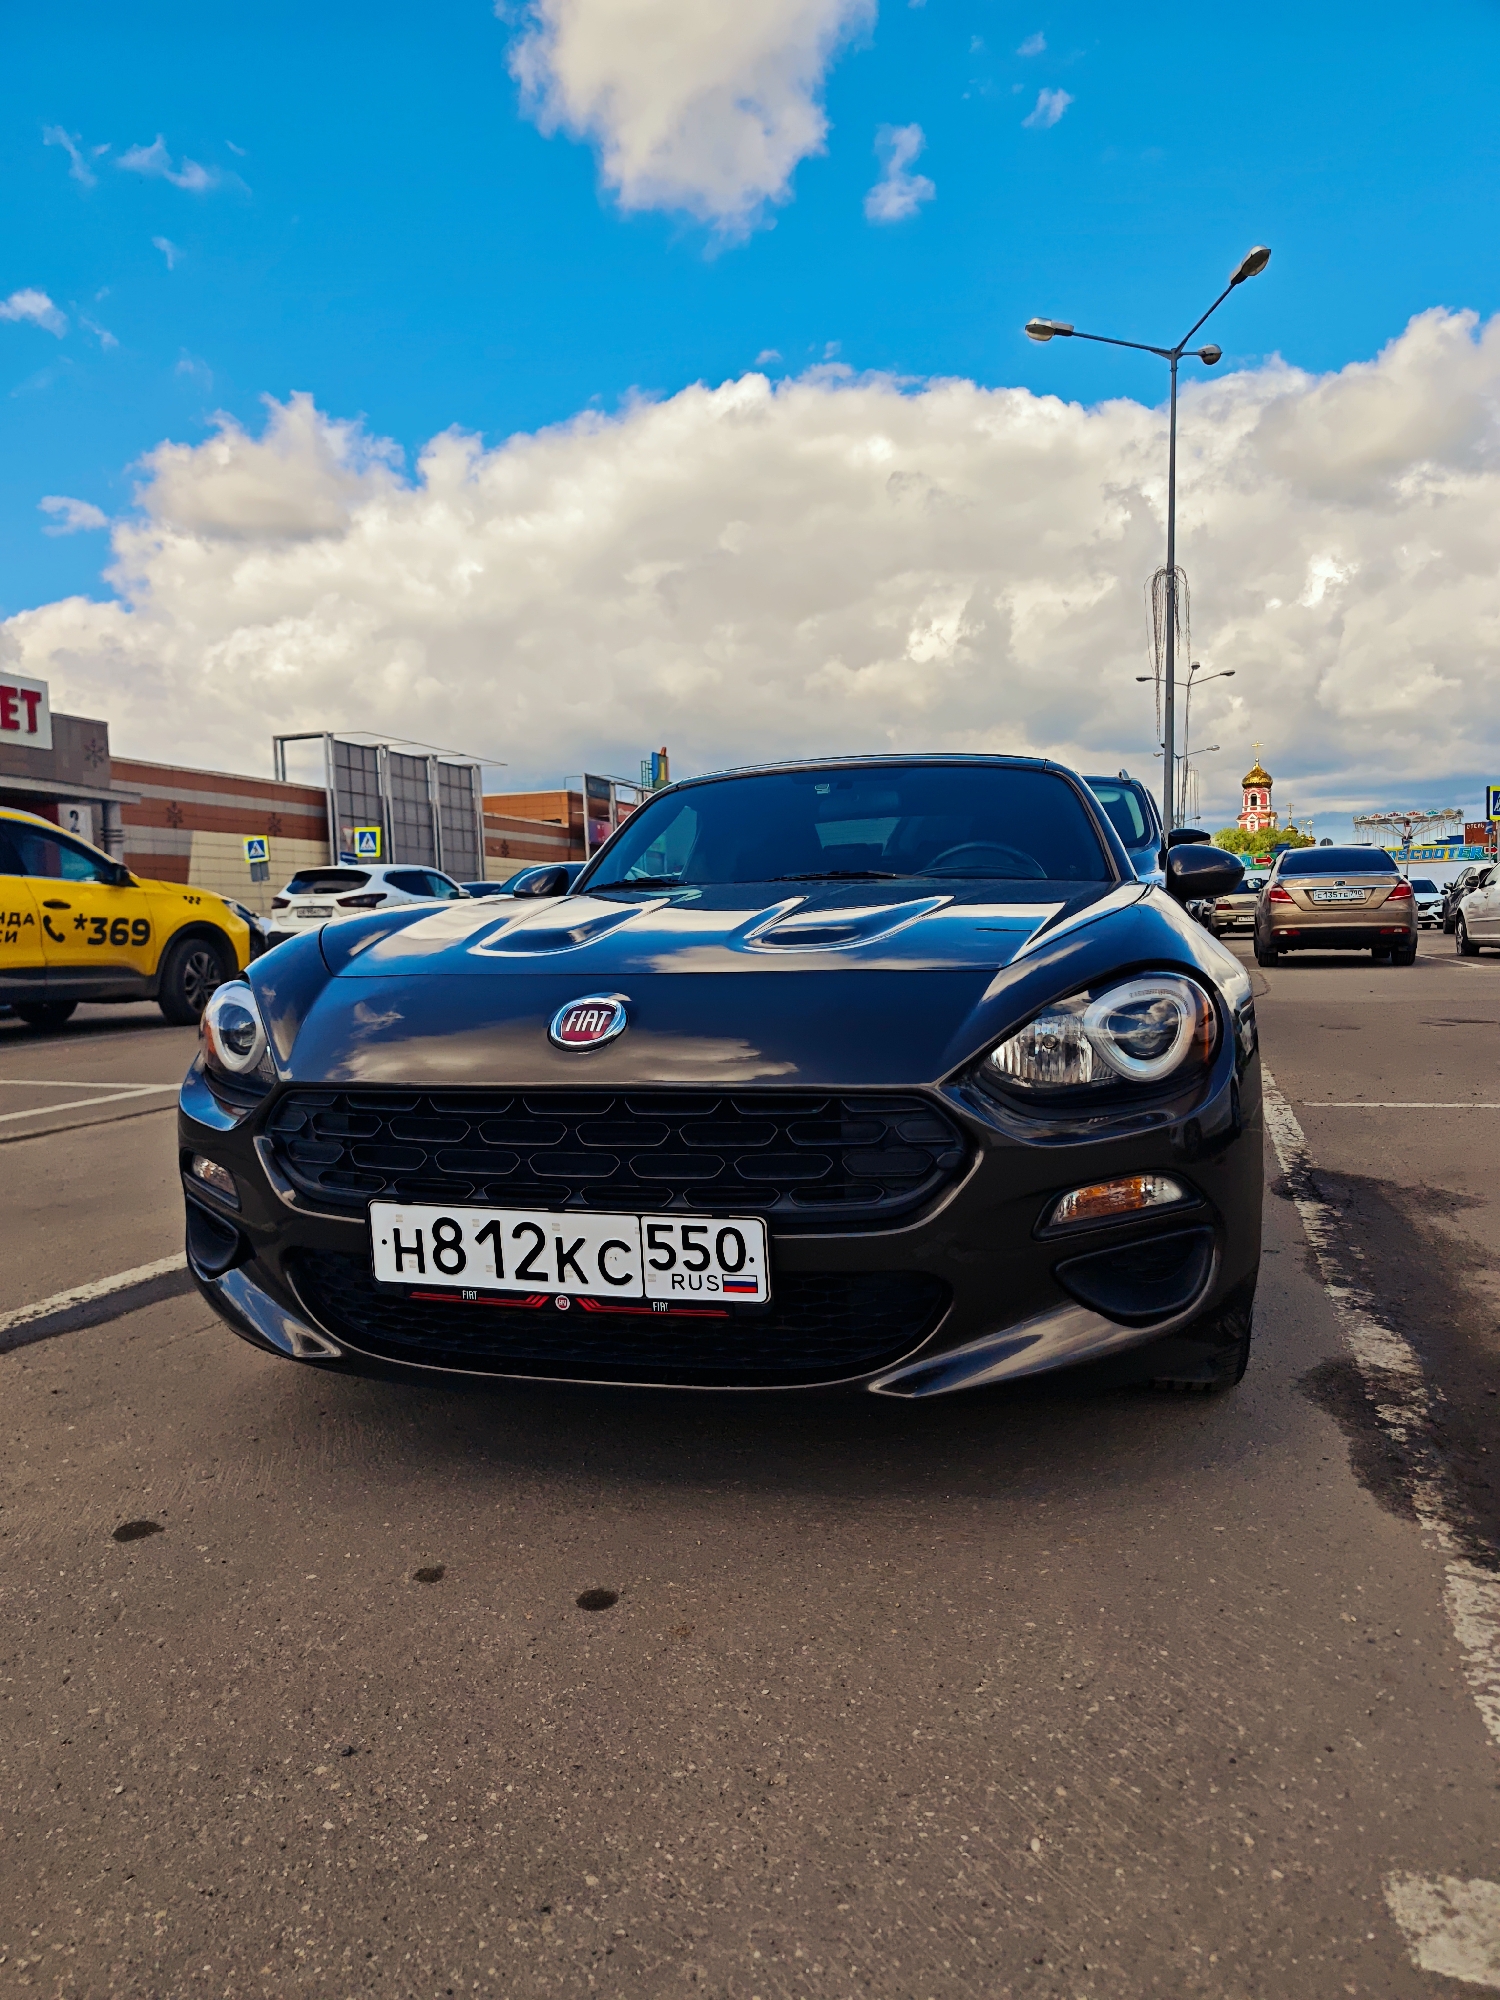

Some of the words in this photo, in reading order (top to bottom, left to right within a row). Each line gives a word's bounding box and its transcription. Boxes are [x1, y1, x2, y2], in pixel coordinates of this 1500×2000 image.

[69, 810, 81, 833] 2
[0, 930, 18, 943] И
[564, 1010, 612, 1032] FIAT
[646, 1224, 747, 1273] 550
[671, 1273, 720, 1292] RUS
[461, 1290, 478, 1301] FIAT
[652, 1301, 669, 1313] FIAT
